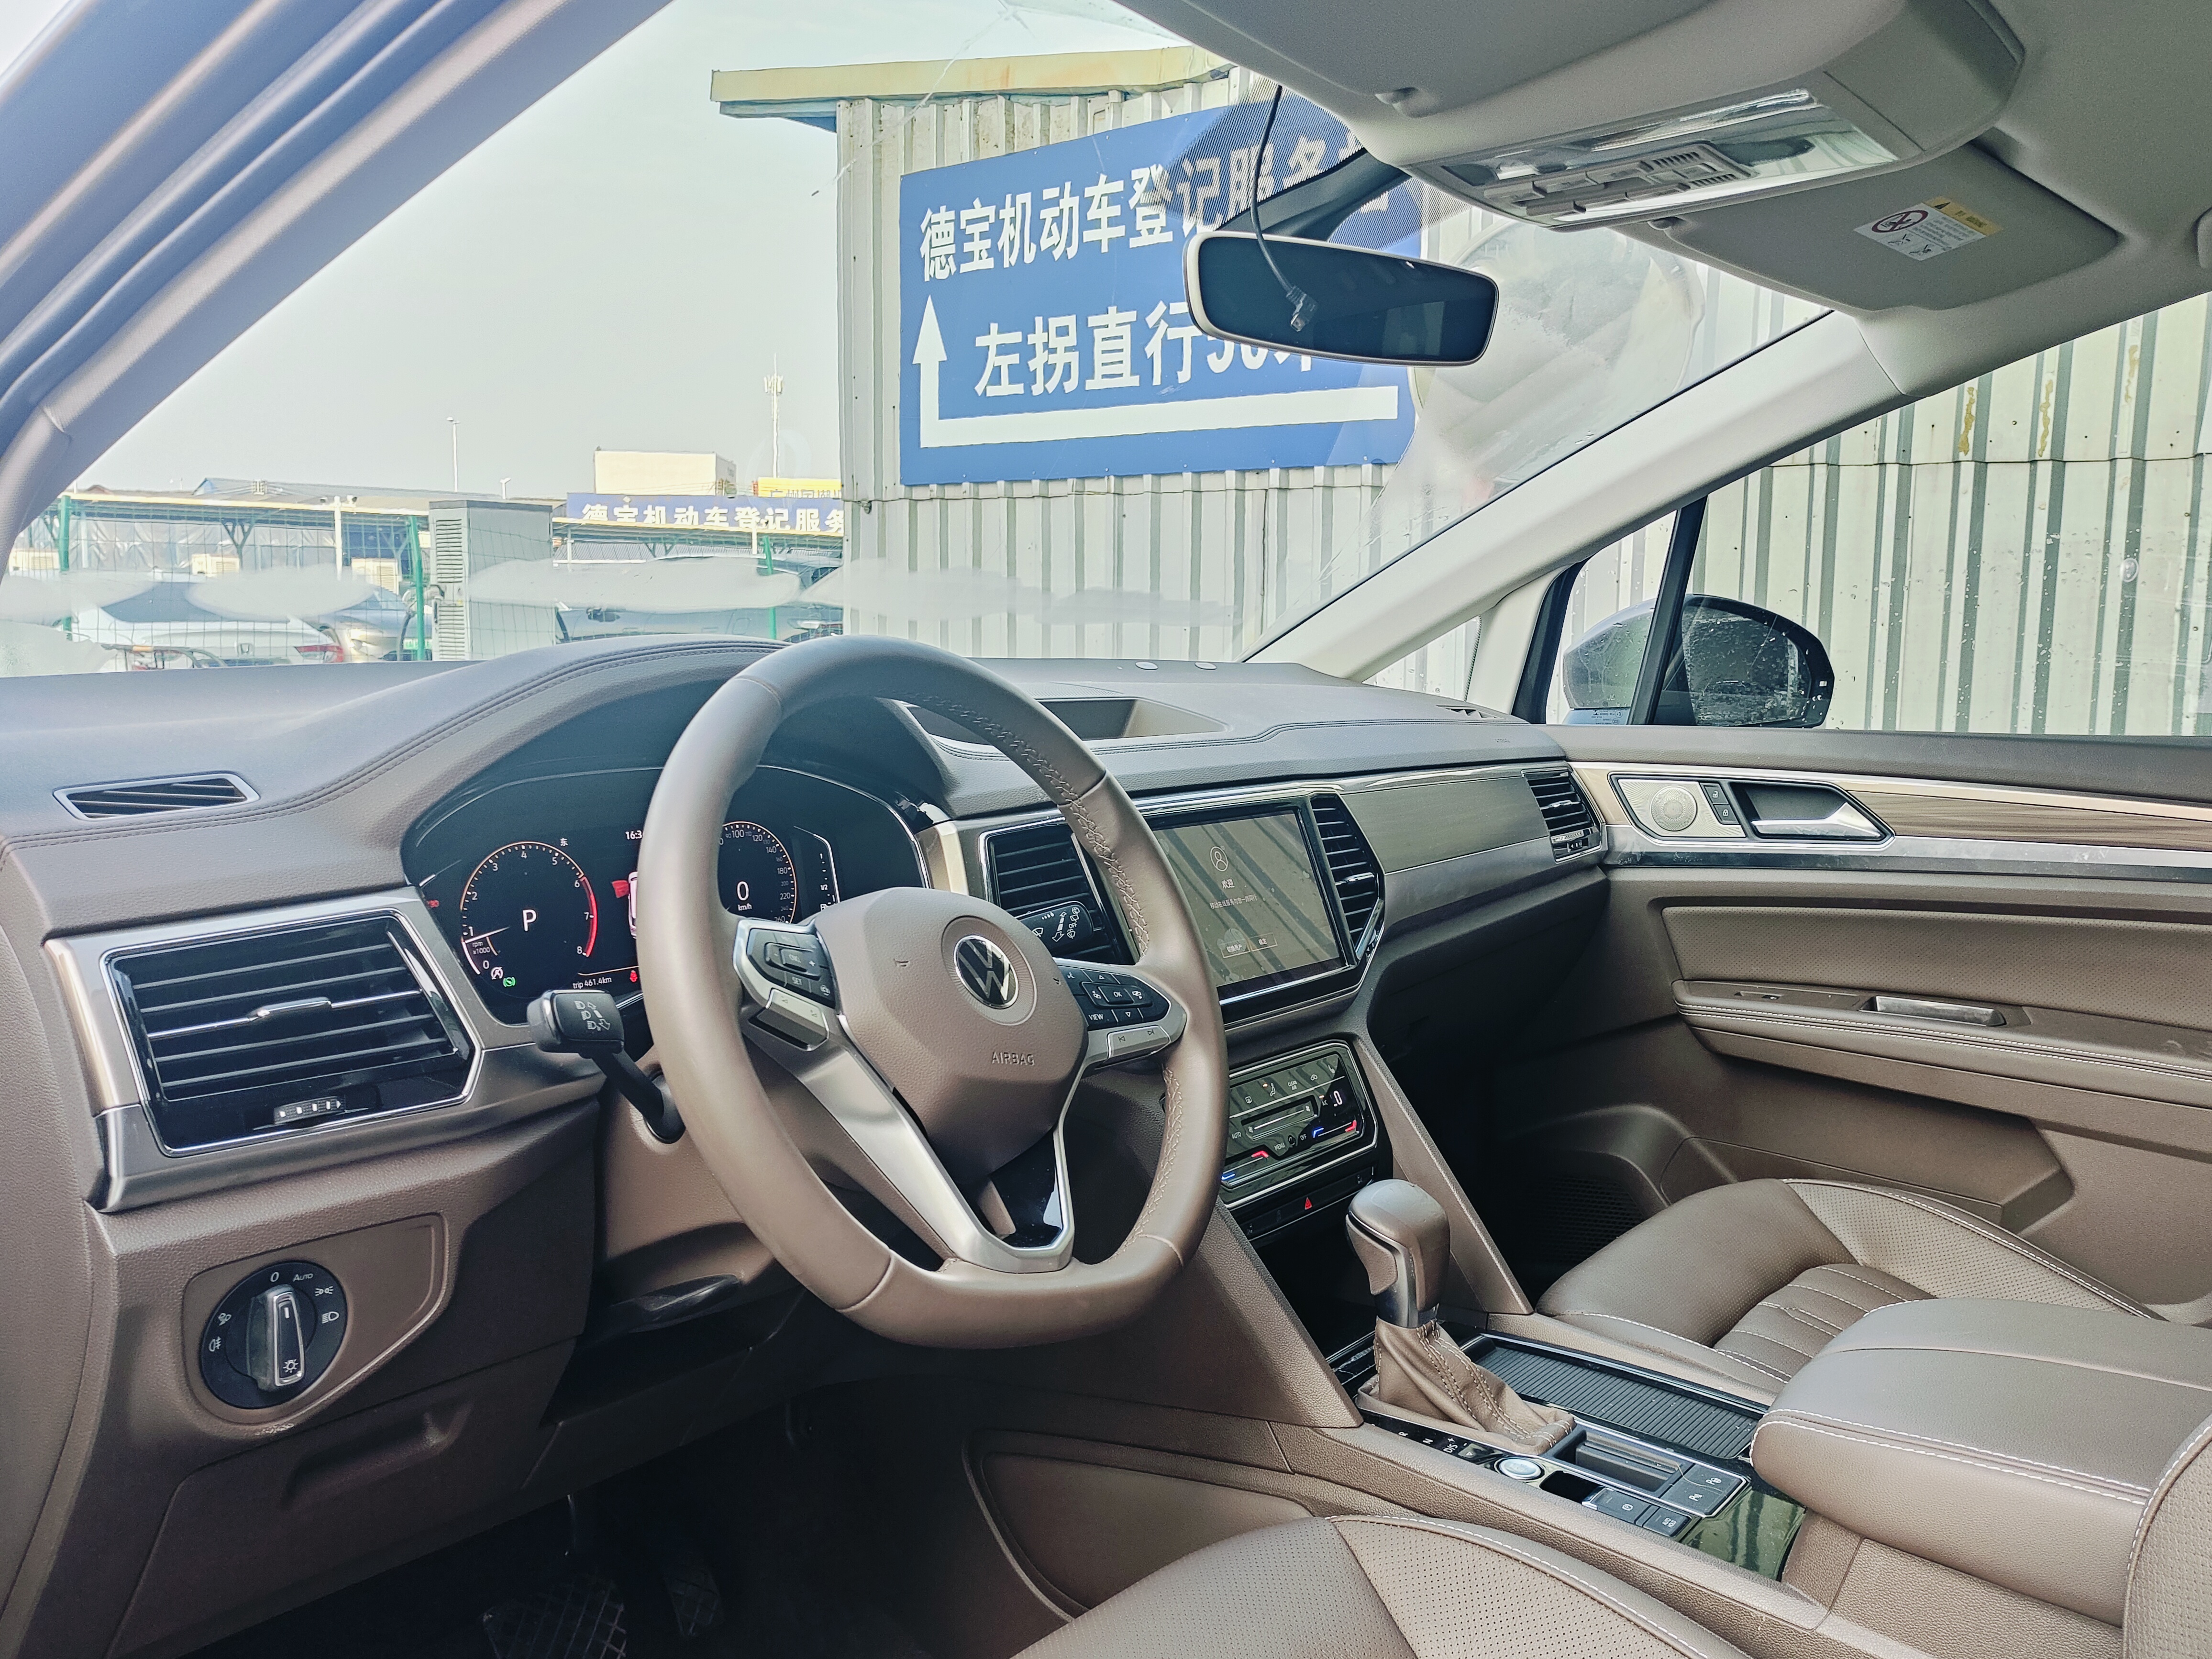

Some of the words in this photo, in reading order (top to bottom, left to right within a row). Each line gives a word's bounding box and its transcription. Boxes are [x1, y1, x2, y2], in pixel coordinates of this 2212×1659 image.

[920, 130, 1387, 282] 德宝机动车登记服务
[975, 299, 1312, 397] 左拐直行
[582, 496, 844, 533] 德宝机动车登记服务
[625, 830, 642, 840] 16:3
[731, 830, 744, 838] 100
[521, 851, 527, 859] 4
[552, 857, 558, 865] 5
[492, 863, 498, 871] 3
[1221, 879, 1235, 889] 欢迎
[737, 881, 749, 901] 0
[472, 892, 478, 900] 2
[522, 909, 537, 931] P
[584, 912, 589, 920] 7
[468, 926, 474, 937] 1
[576, 946, 583, 954] 8
[483, 960, 489, 969] 0
[791, 976, 802, 985] SET
[992, 1051, 1035, 1067] AIRBAG
[1231, 1131, 1242, 1140] AUTO
[1274, 1142, 1285, 1151] MENU
